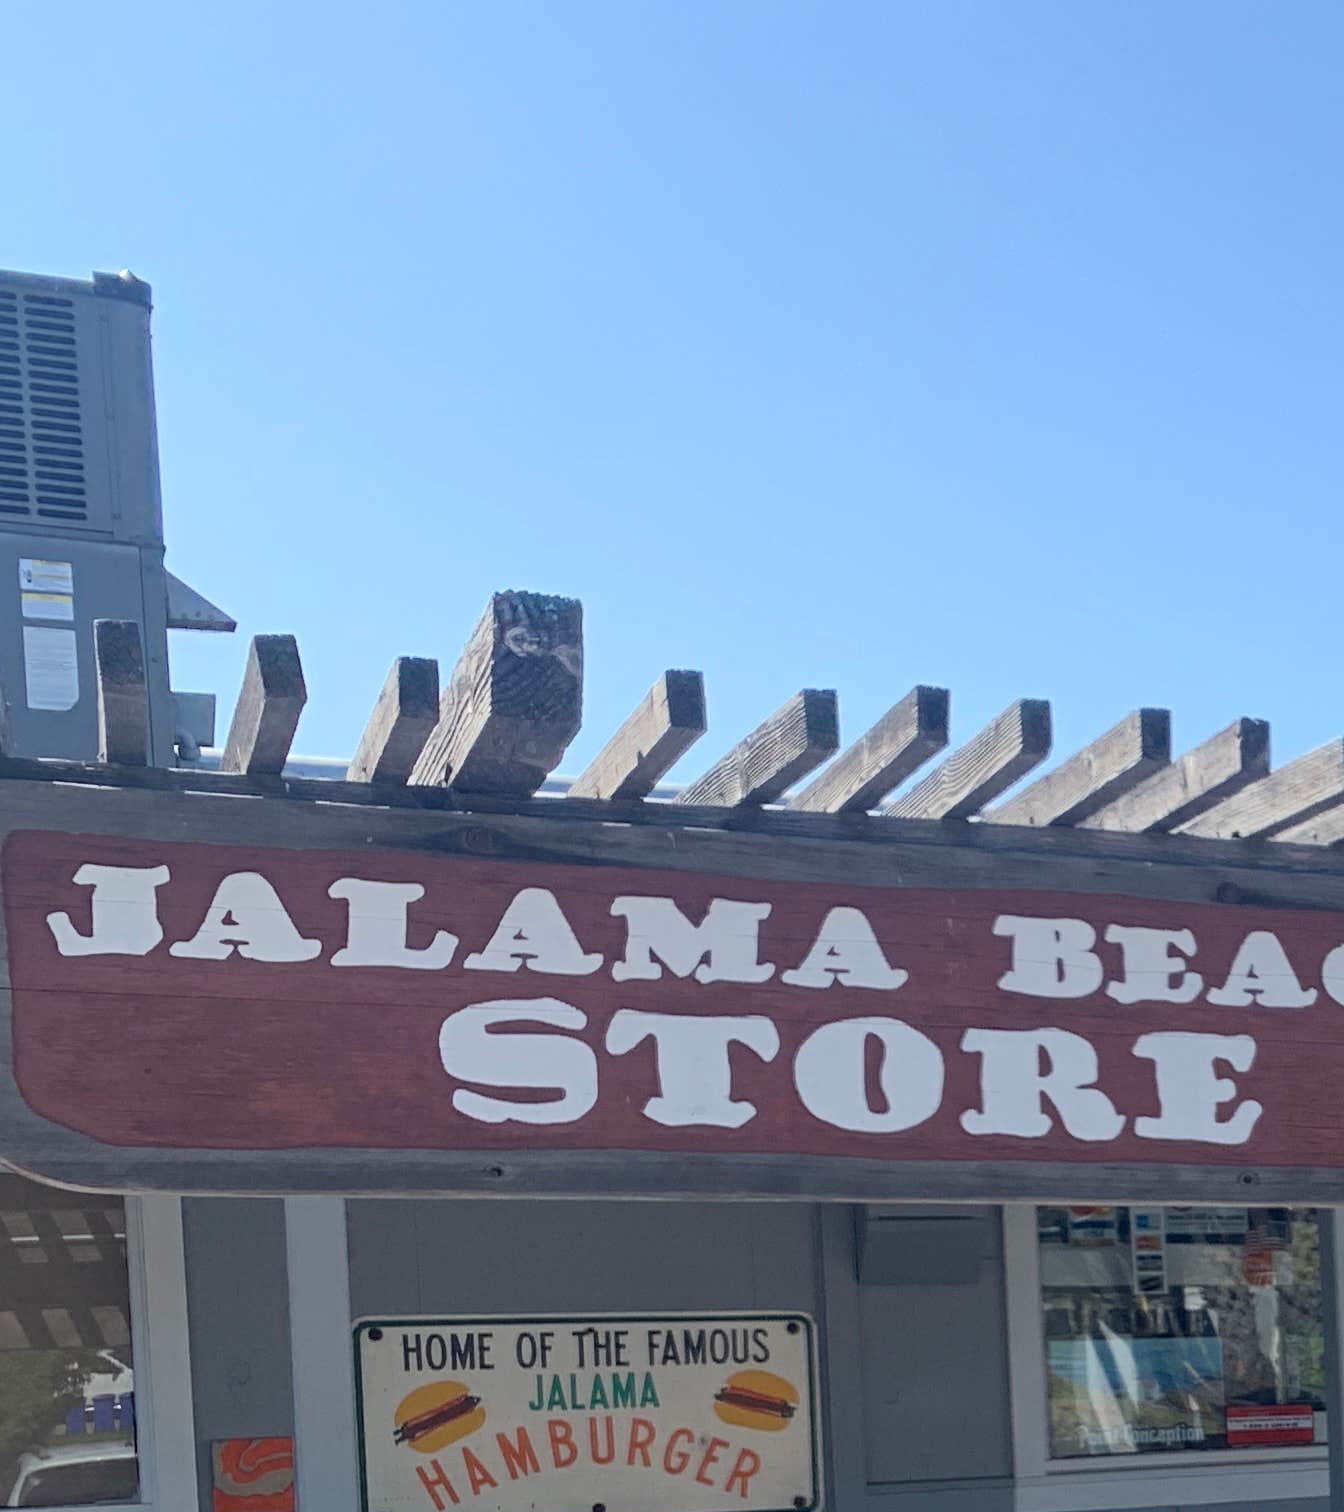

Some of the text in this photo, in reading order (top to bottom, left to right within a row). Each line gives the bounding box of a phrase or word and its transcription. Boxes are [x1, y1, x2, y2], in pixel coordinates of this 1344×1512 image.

[46, 862, 908, 989] JALAMA
[439, 997, 1263, 1144] STORE
[402, 1328, 771, 1372] HOME OF THE FAMOUS
[529, 1372, 660, 1412] JALAMA
[415, 1416, 762, 1512] HAMBURGER
